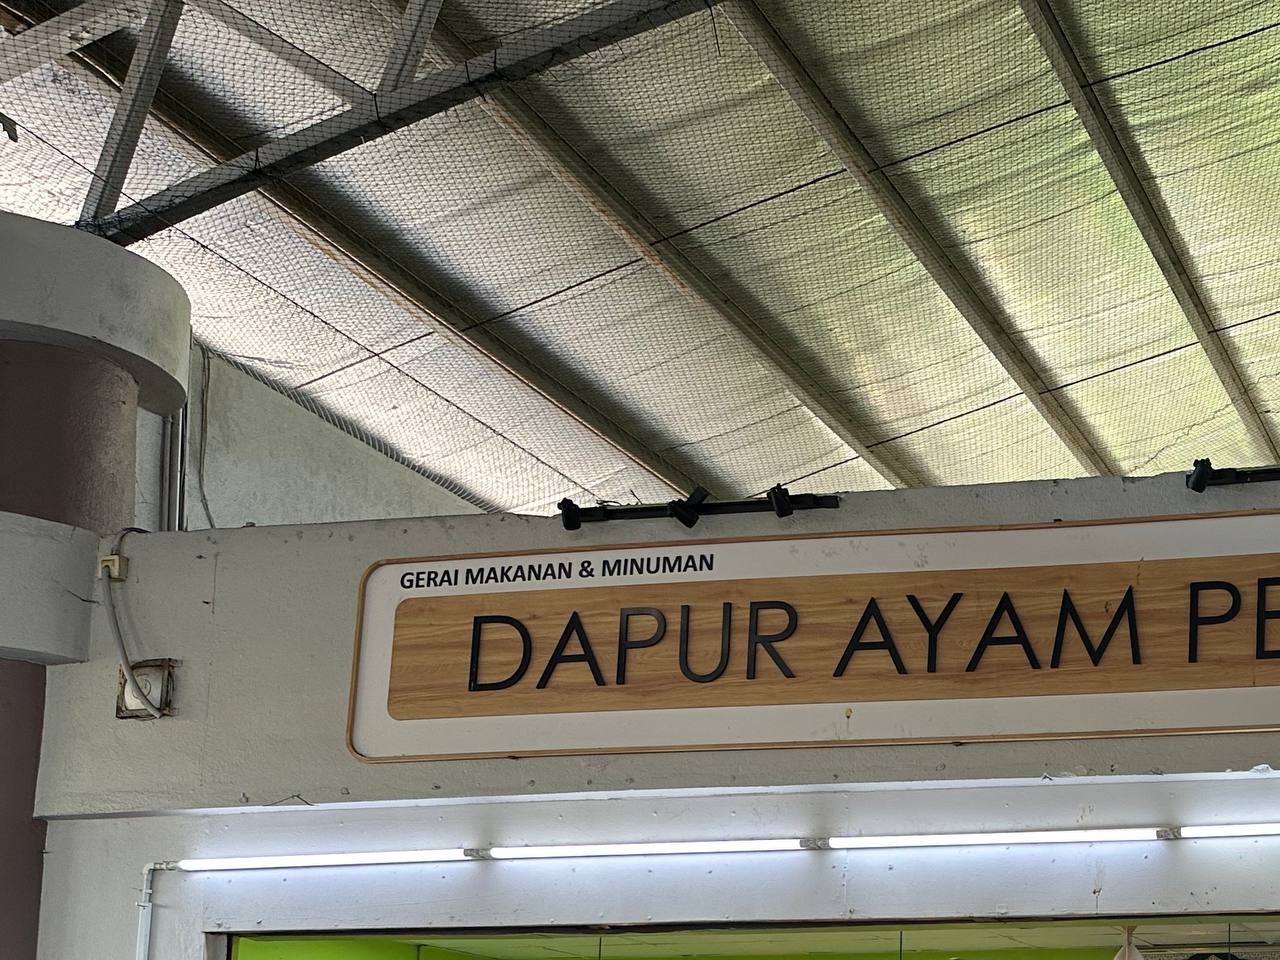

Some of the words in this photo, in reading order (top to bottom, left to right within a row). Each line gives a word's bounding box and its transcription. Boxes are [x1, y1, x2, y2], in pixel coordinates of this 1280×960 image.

[400, 569, 460, 590] GERAI
[464, 562, 573, 586] MAKANAN
[579, 560, 595, 578] &
[601, 554, 714, 577] MINUMAN
[468, 599, 799, 692] DAPUR
[832, 585, 1142, 677] AYAM
